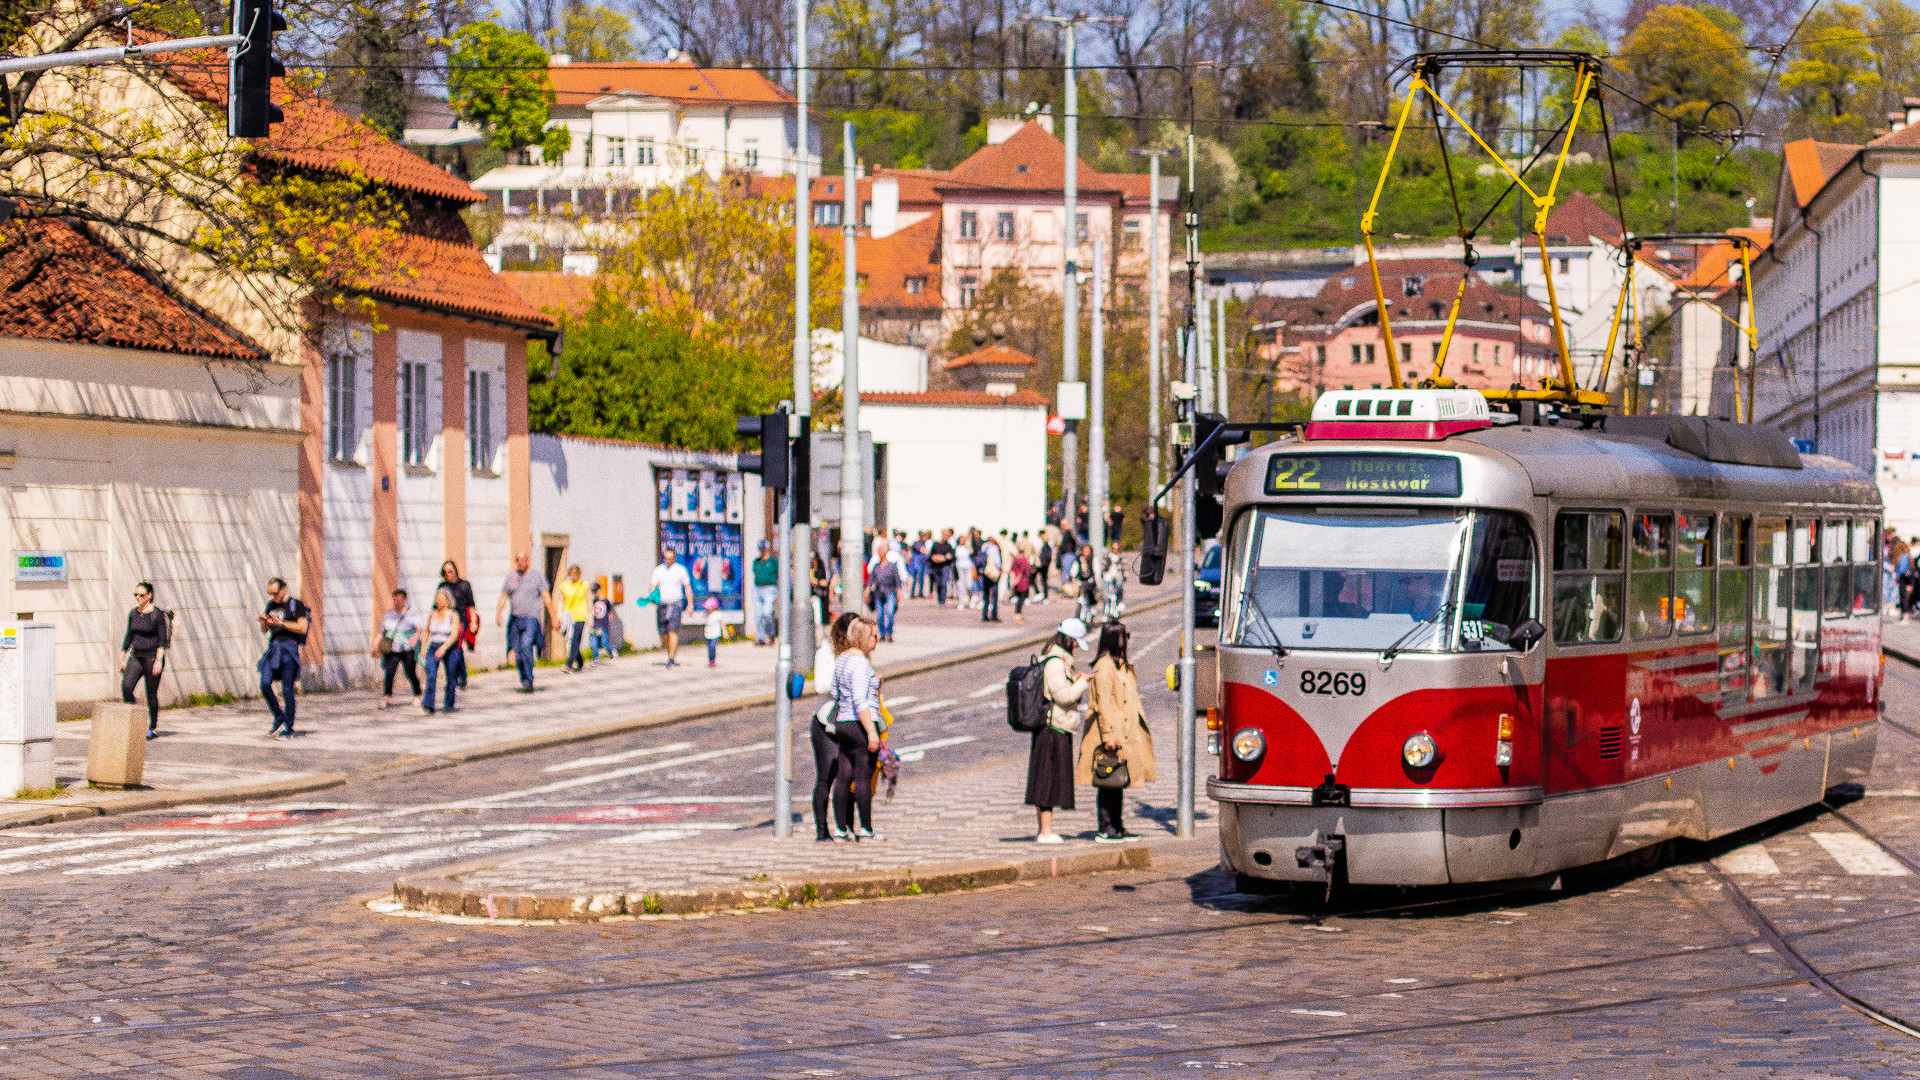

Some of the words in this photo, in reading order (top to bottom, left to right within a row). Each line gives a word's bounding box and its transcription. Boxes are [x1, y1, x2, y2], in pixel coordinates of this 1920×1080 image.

[1276, 458, 1321, 489] 22
[1462, 620, 1484, 639] 531
[1300, 670, 1367, 696] 8269
